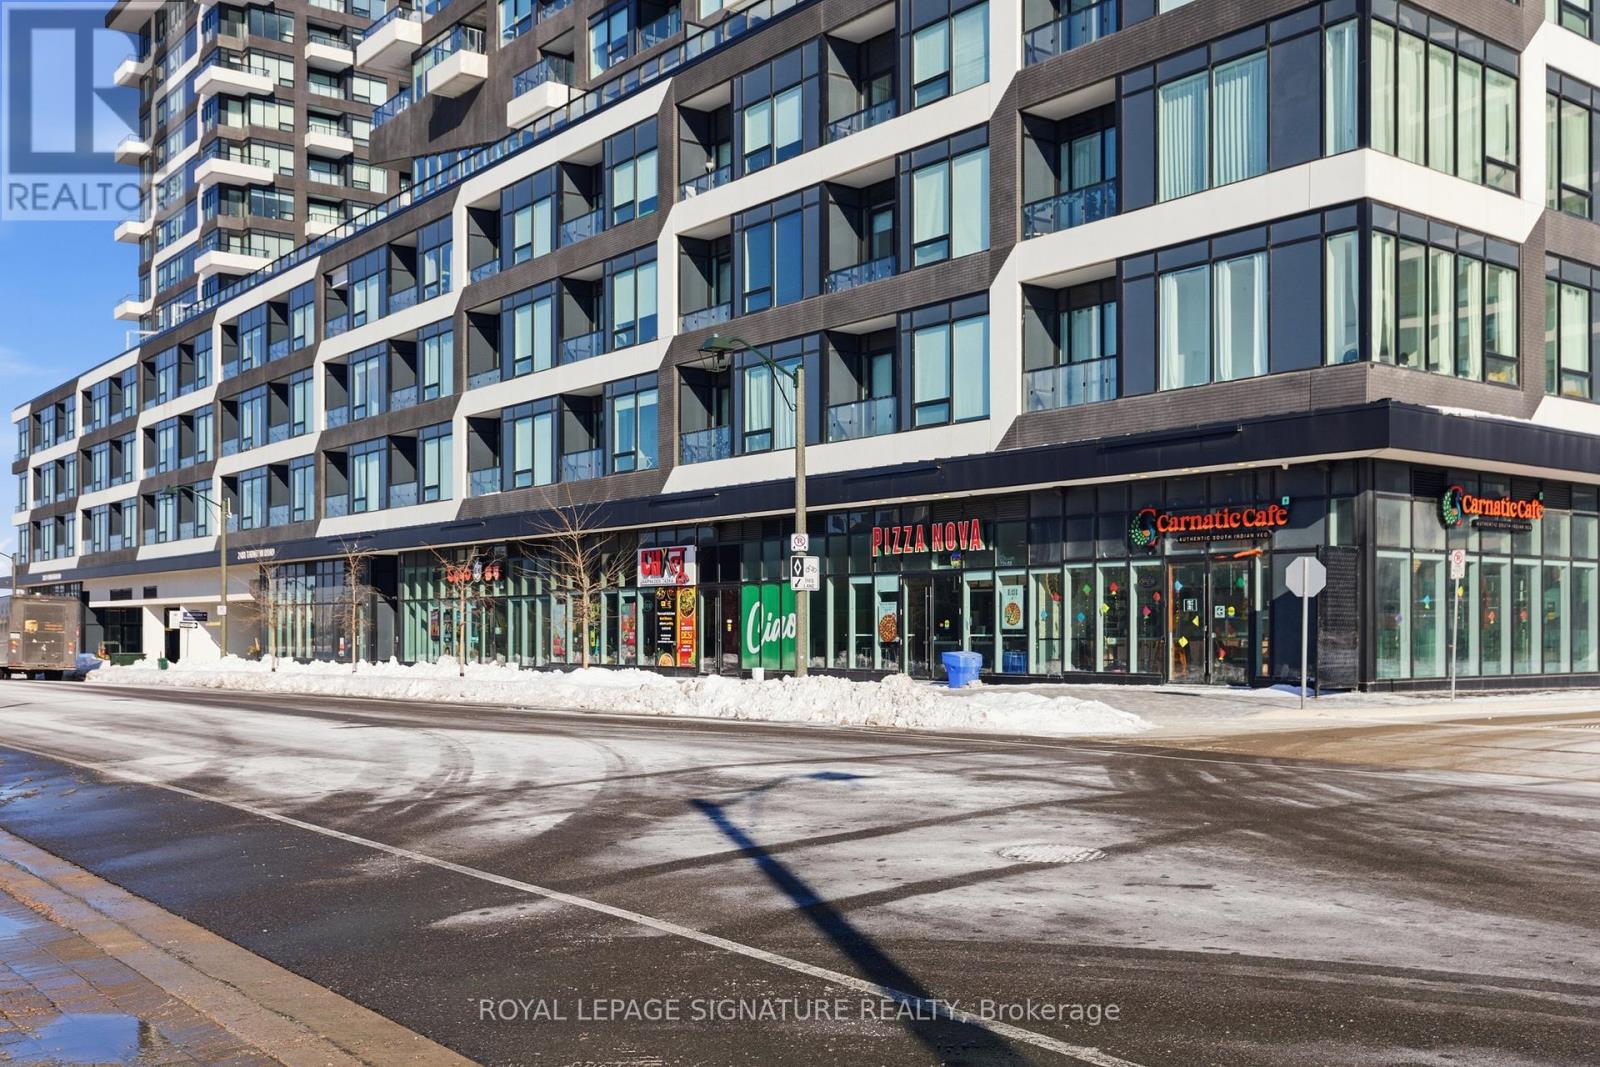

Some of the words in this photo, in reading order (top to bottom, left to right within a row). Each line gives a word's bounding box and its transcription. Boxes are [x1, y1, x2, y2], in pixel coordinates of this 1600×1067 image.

[1157, 507, 1241, 533] Carnatic
[1462, 495, 1517, 518] Carnatic
[872, 525, 926, 558] PIZZA
[932, 518, 982, 551] NOVA
[747, 601, 797, 654] Ciao
